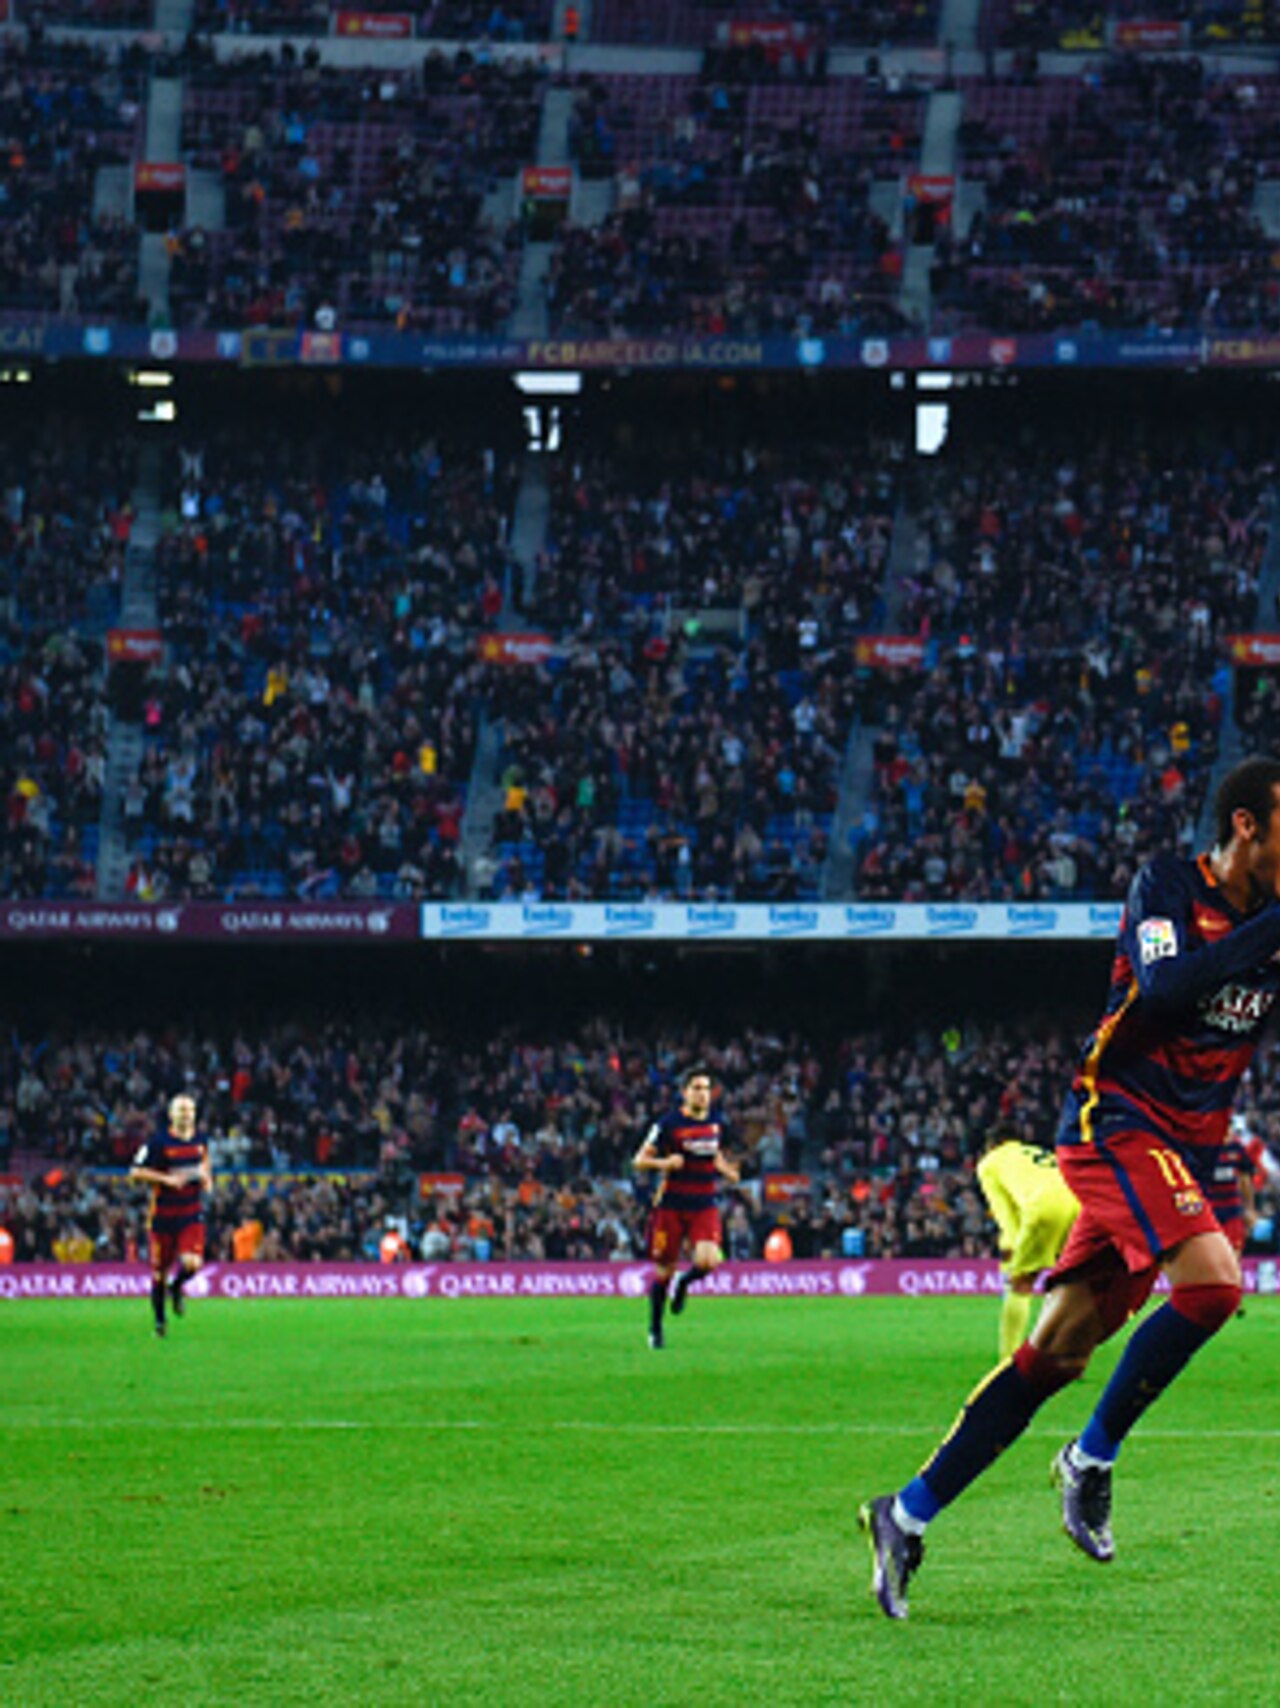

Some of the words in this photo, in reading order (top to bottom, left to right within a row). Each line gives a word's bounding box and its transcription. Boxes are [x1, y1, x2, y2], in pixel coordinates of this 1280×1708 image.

[8, 911, 70, 931] QATAR
[222, 912, 282, 931] QATAR
[1089, 906, 1123, 924] bek
[1148, 1149, 1195, 1186] 11
[1, 1273, 75, 1297] QATAR
[221, 1273, 299, 1297] QATAR
[303, 1273, 399, 1294] AIRWAYS
[439, 1273, 517, 1297] QATAR
[520, 1273, 615, 1294] AIRWAYS
[738, 1272, 834, 1294] AIRWAYS
[899, 1270, 979, 1297] QATAR
